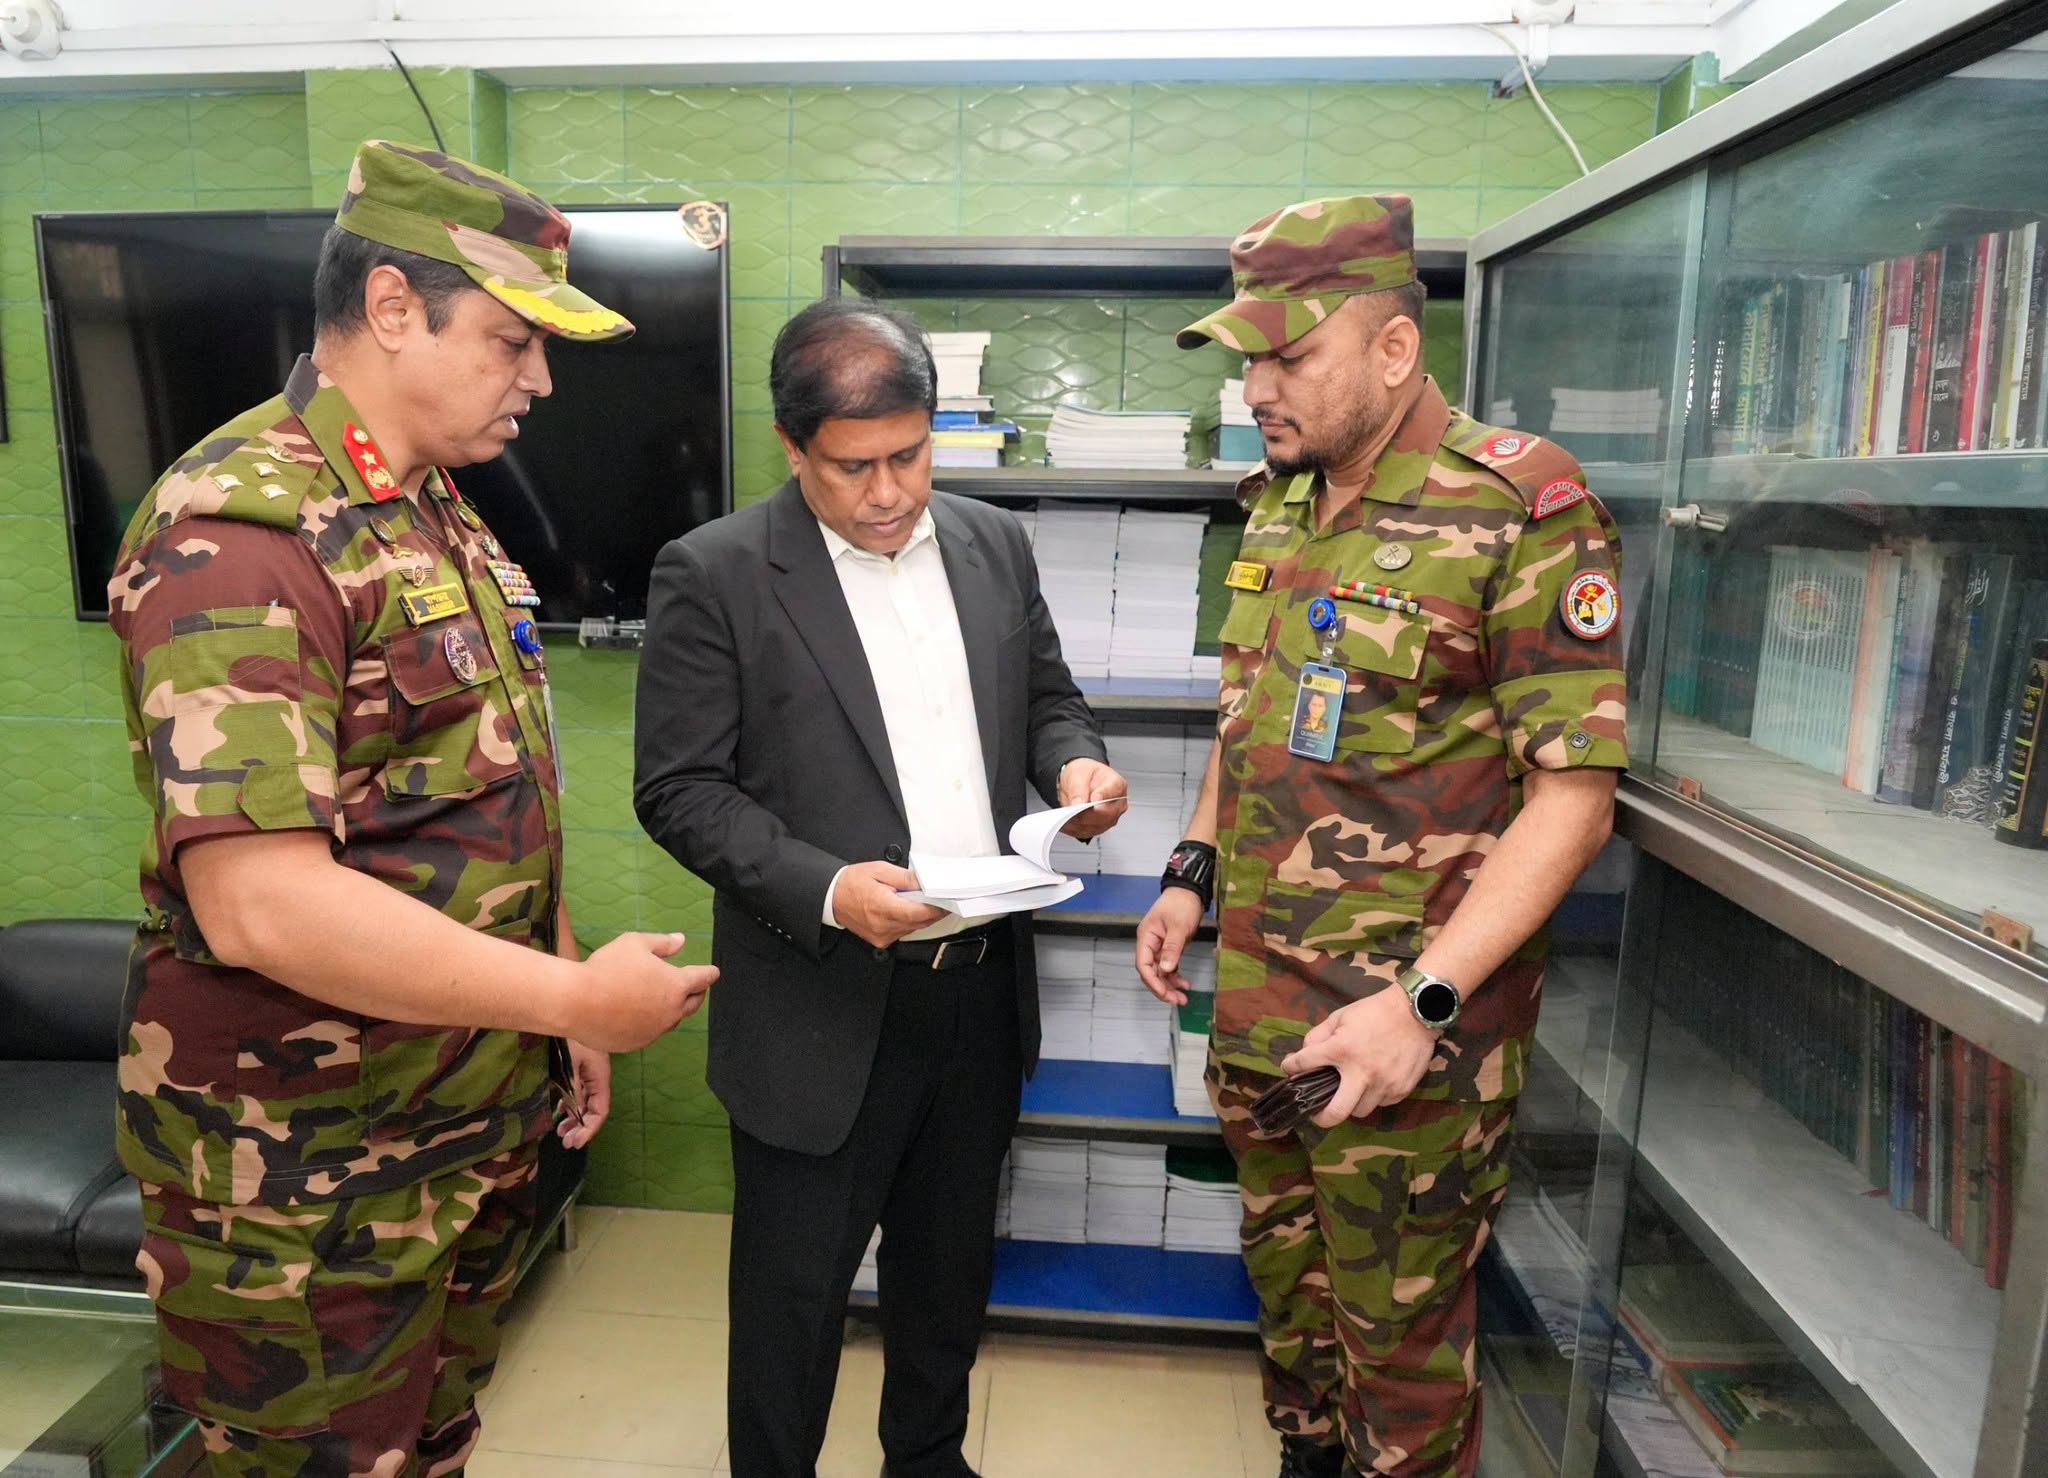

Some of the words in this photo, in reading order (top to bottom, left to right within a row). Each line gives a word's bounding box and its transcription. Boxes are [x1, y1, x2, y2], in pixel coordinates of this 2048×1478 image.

[1943, 709, 1957, 740] বাংলা
[2000, 708, 2013, 739] বাংলা
[1935, 743, 1952, 785] মর্মবাণী
[1992, 742, 2007, 784] মর্মবাণী
